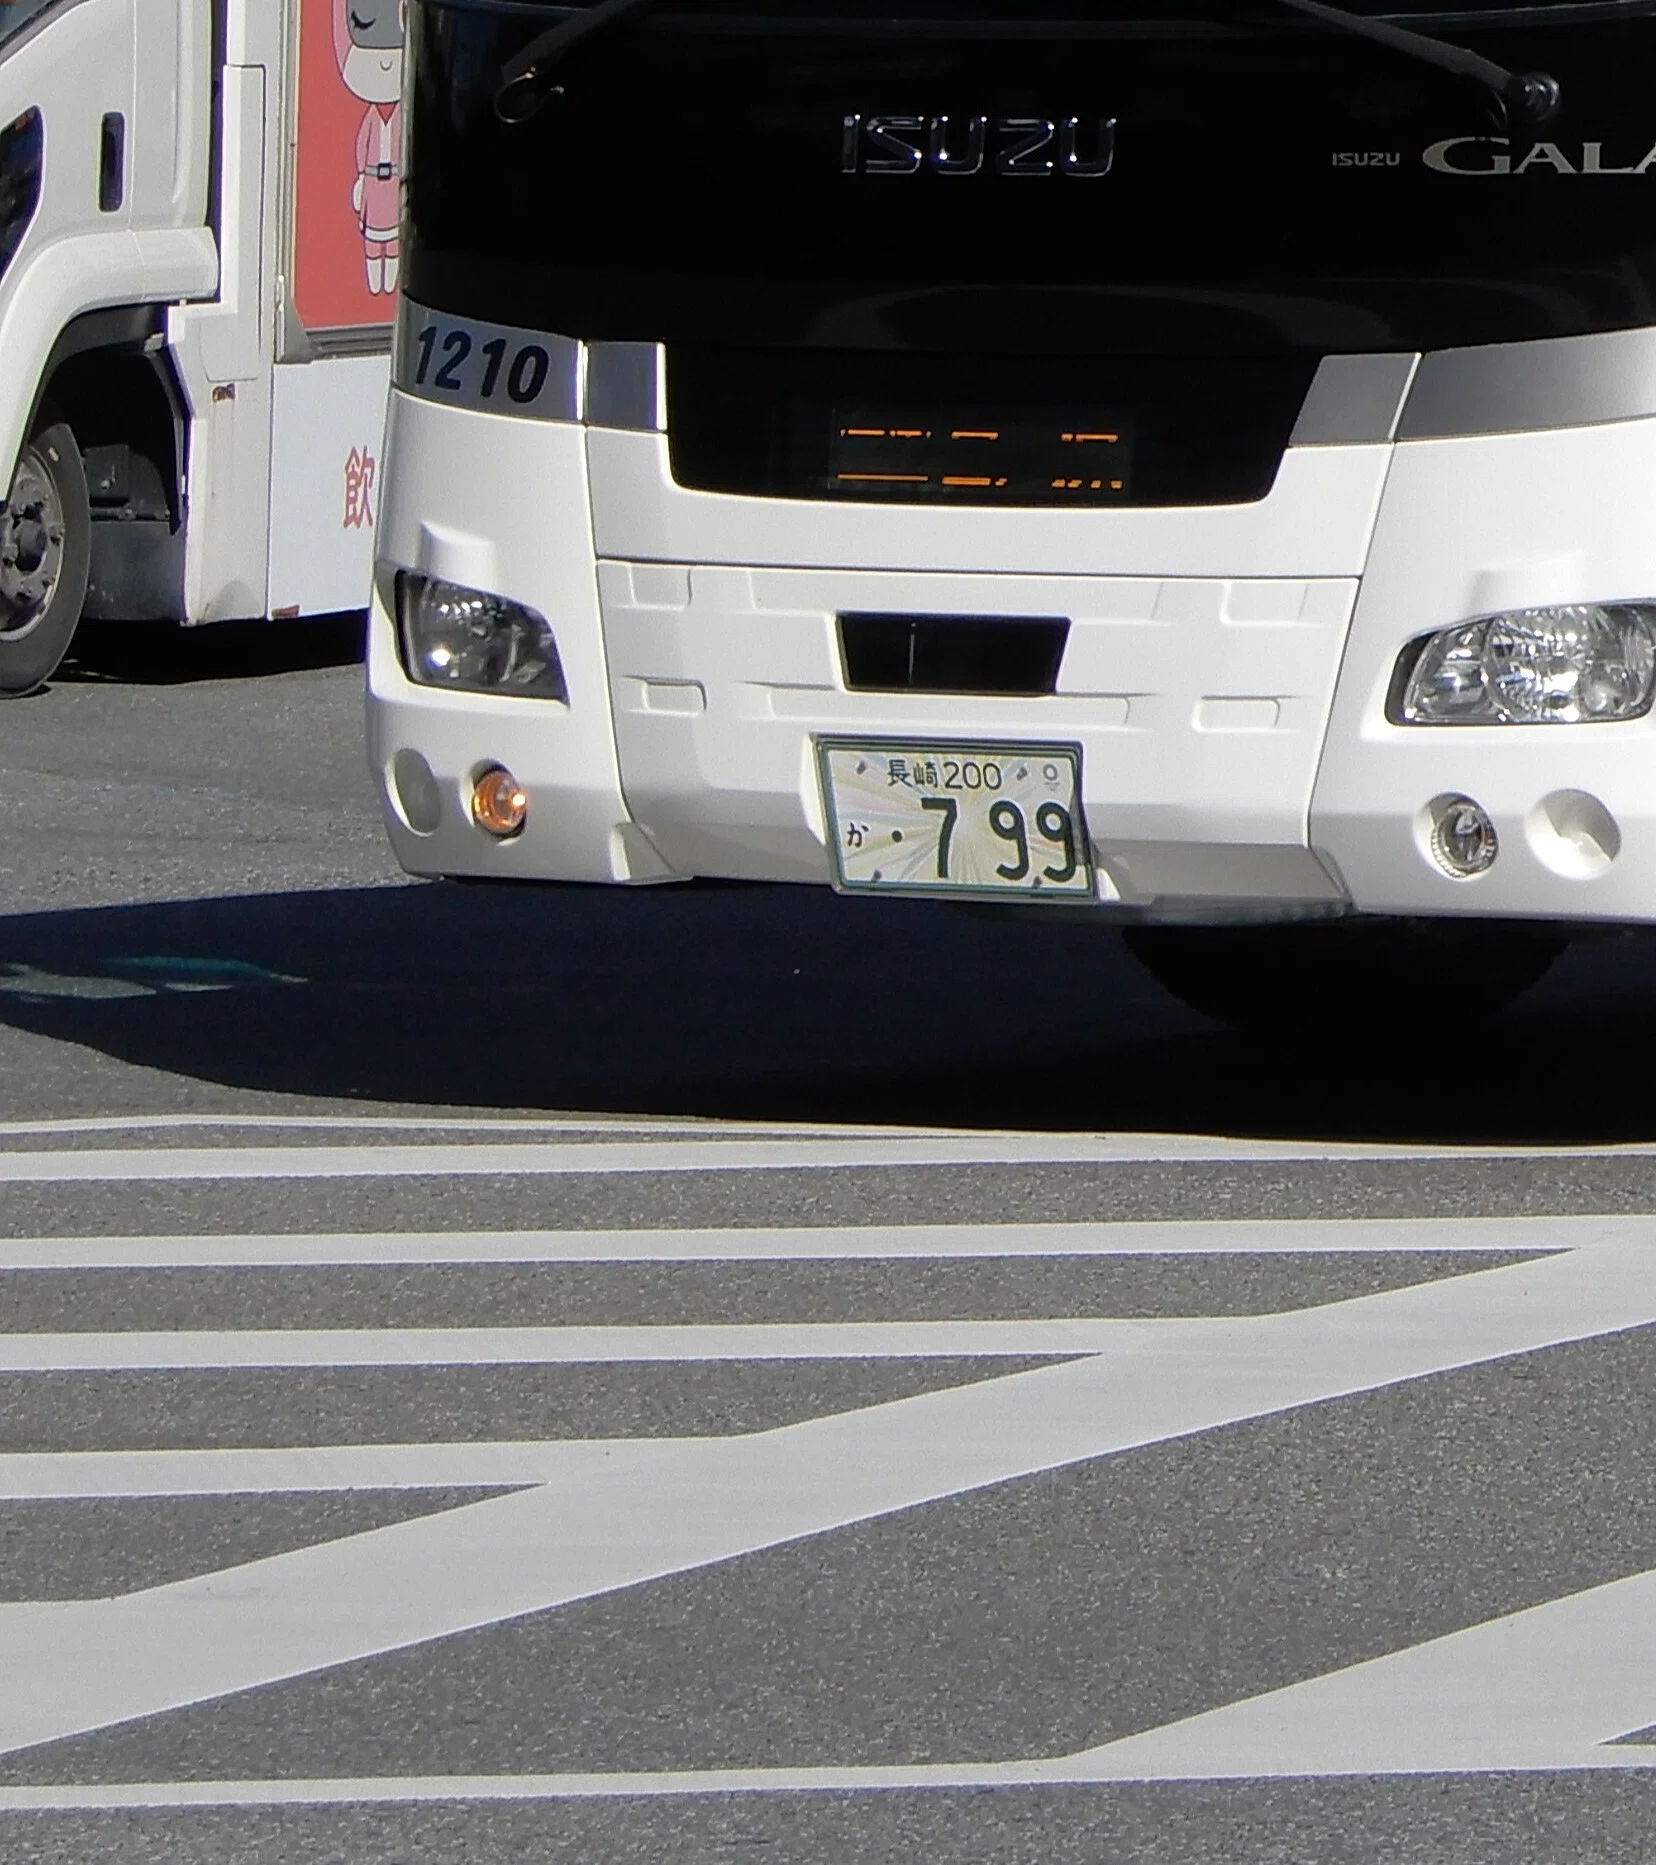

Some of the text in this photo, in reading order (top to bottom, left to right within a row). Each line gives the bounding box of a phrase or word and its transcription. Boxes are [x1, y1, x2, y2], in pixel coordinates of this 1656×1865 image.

[841, 114, 1117, 177] ISUZU
[1332, 152, 1400, 168] ISUZU
[415, 326, 550, 404] 1210
[846, 822, 880, 848] か
